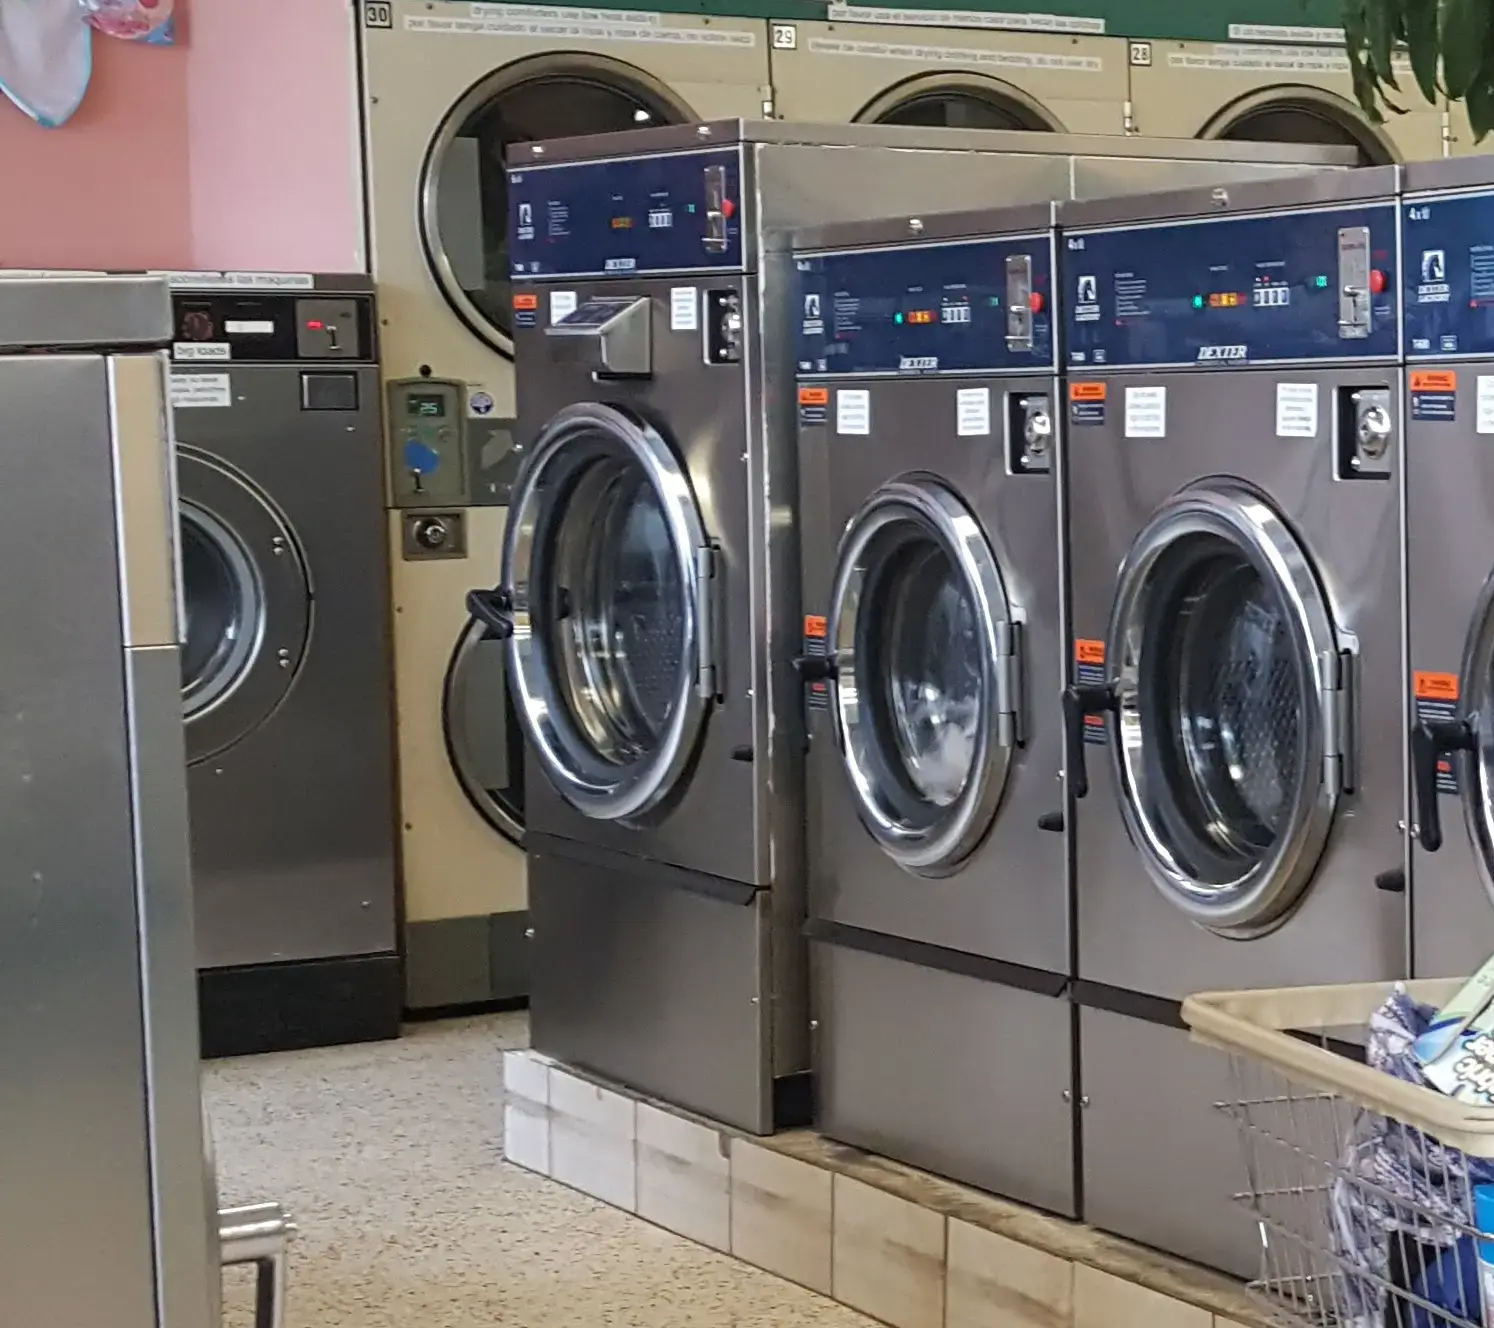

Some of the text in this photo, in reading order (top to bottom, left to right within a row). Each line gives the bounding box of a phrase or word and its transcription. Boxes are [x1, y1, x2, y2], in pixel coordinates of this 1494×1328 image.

[367, 6, 388, 24] 30
[775, 28, 794, 45] 29
[1132, 46, 1149, 62] 28
[1197, 345, 1248, 359] DEXTER
